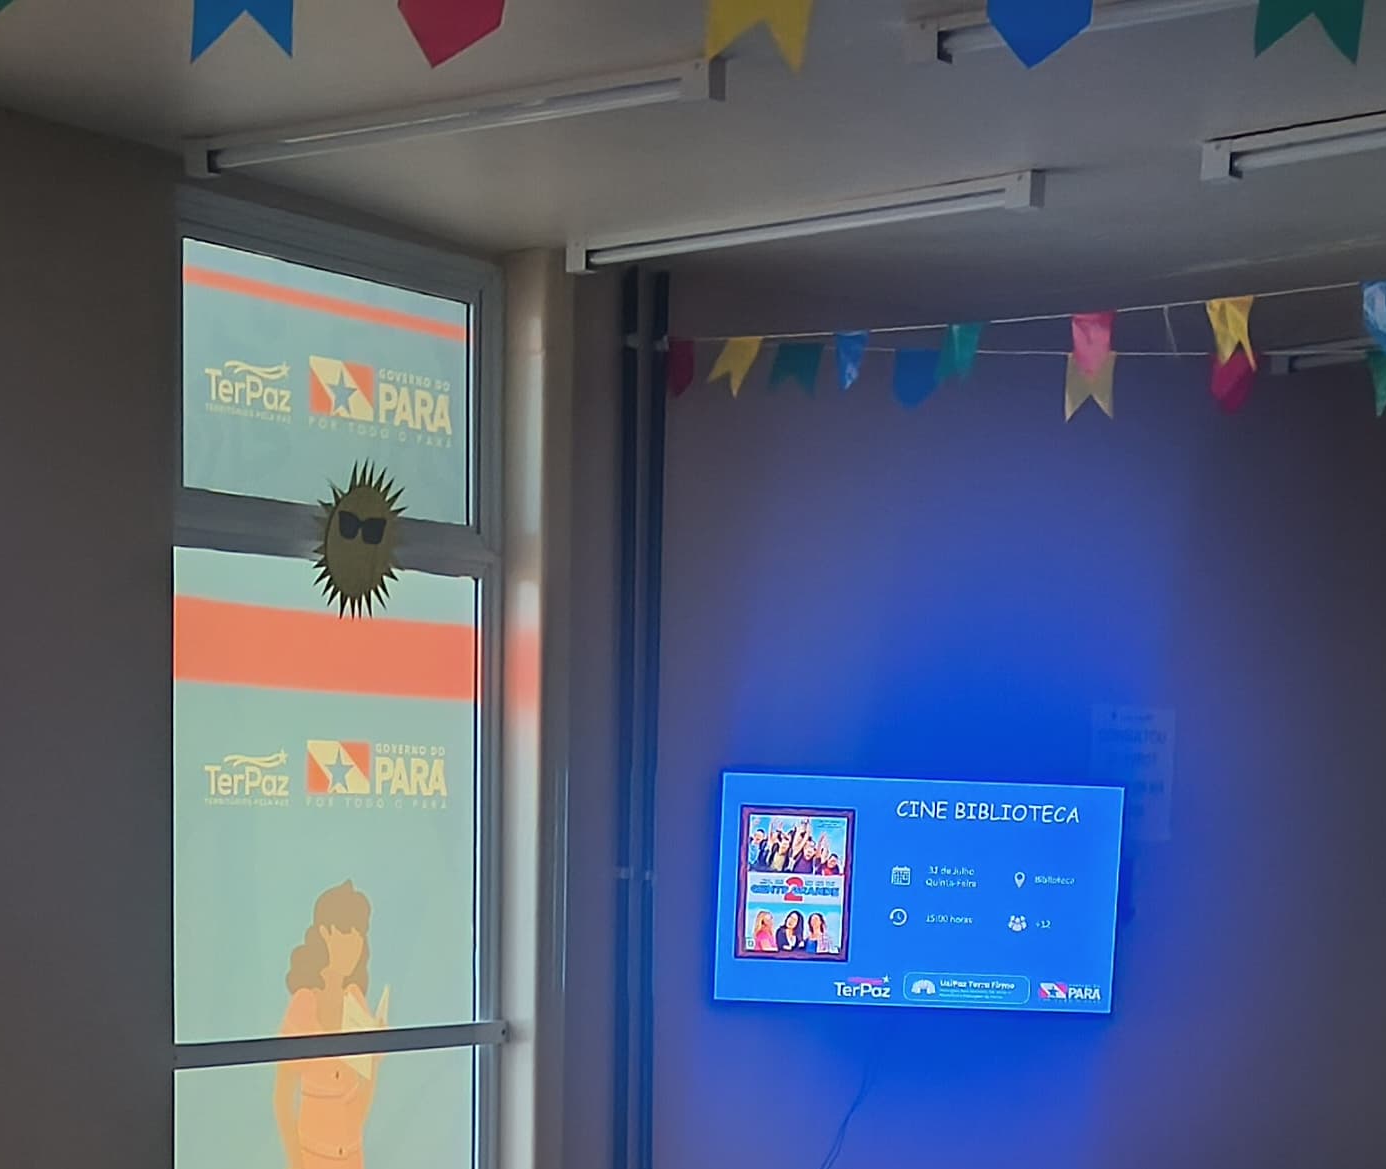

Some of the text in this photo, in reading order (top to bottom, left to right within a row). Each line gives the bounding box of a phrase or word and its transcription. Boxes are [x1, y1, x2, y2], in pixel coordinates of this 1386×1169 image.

[205, 367, 292, 413] TerPaz
[204, 765, 290, 797] TerPaz
[896, 800, 1080, 824] CINE BIBLIOTECA
[834, 981, 891, 998] TerPaz
